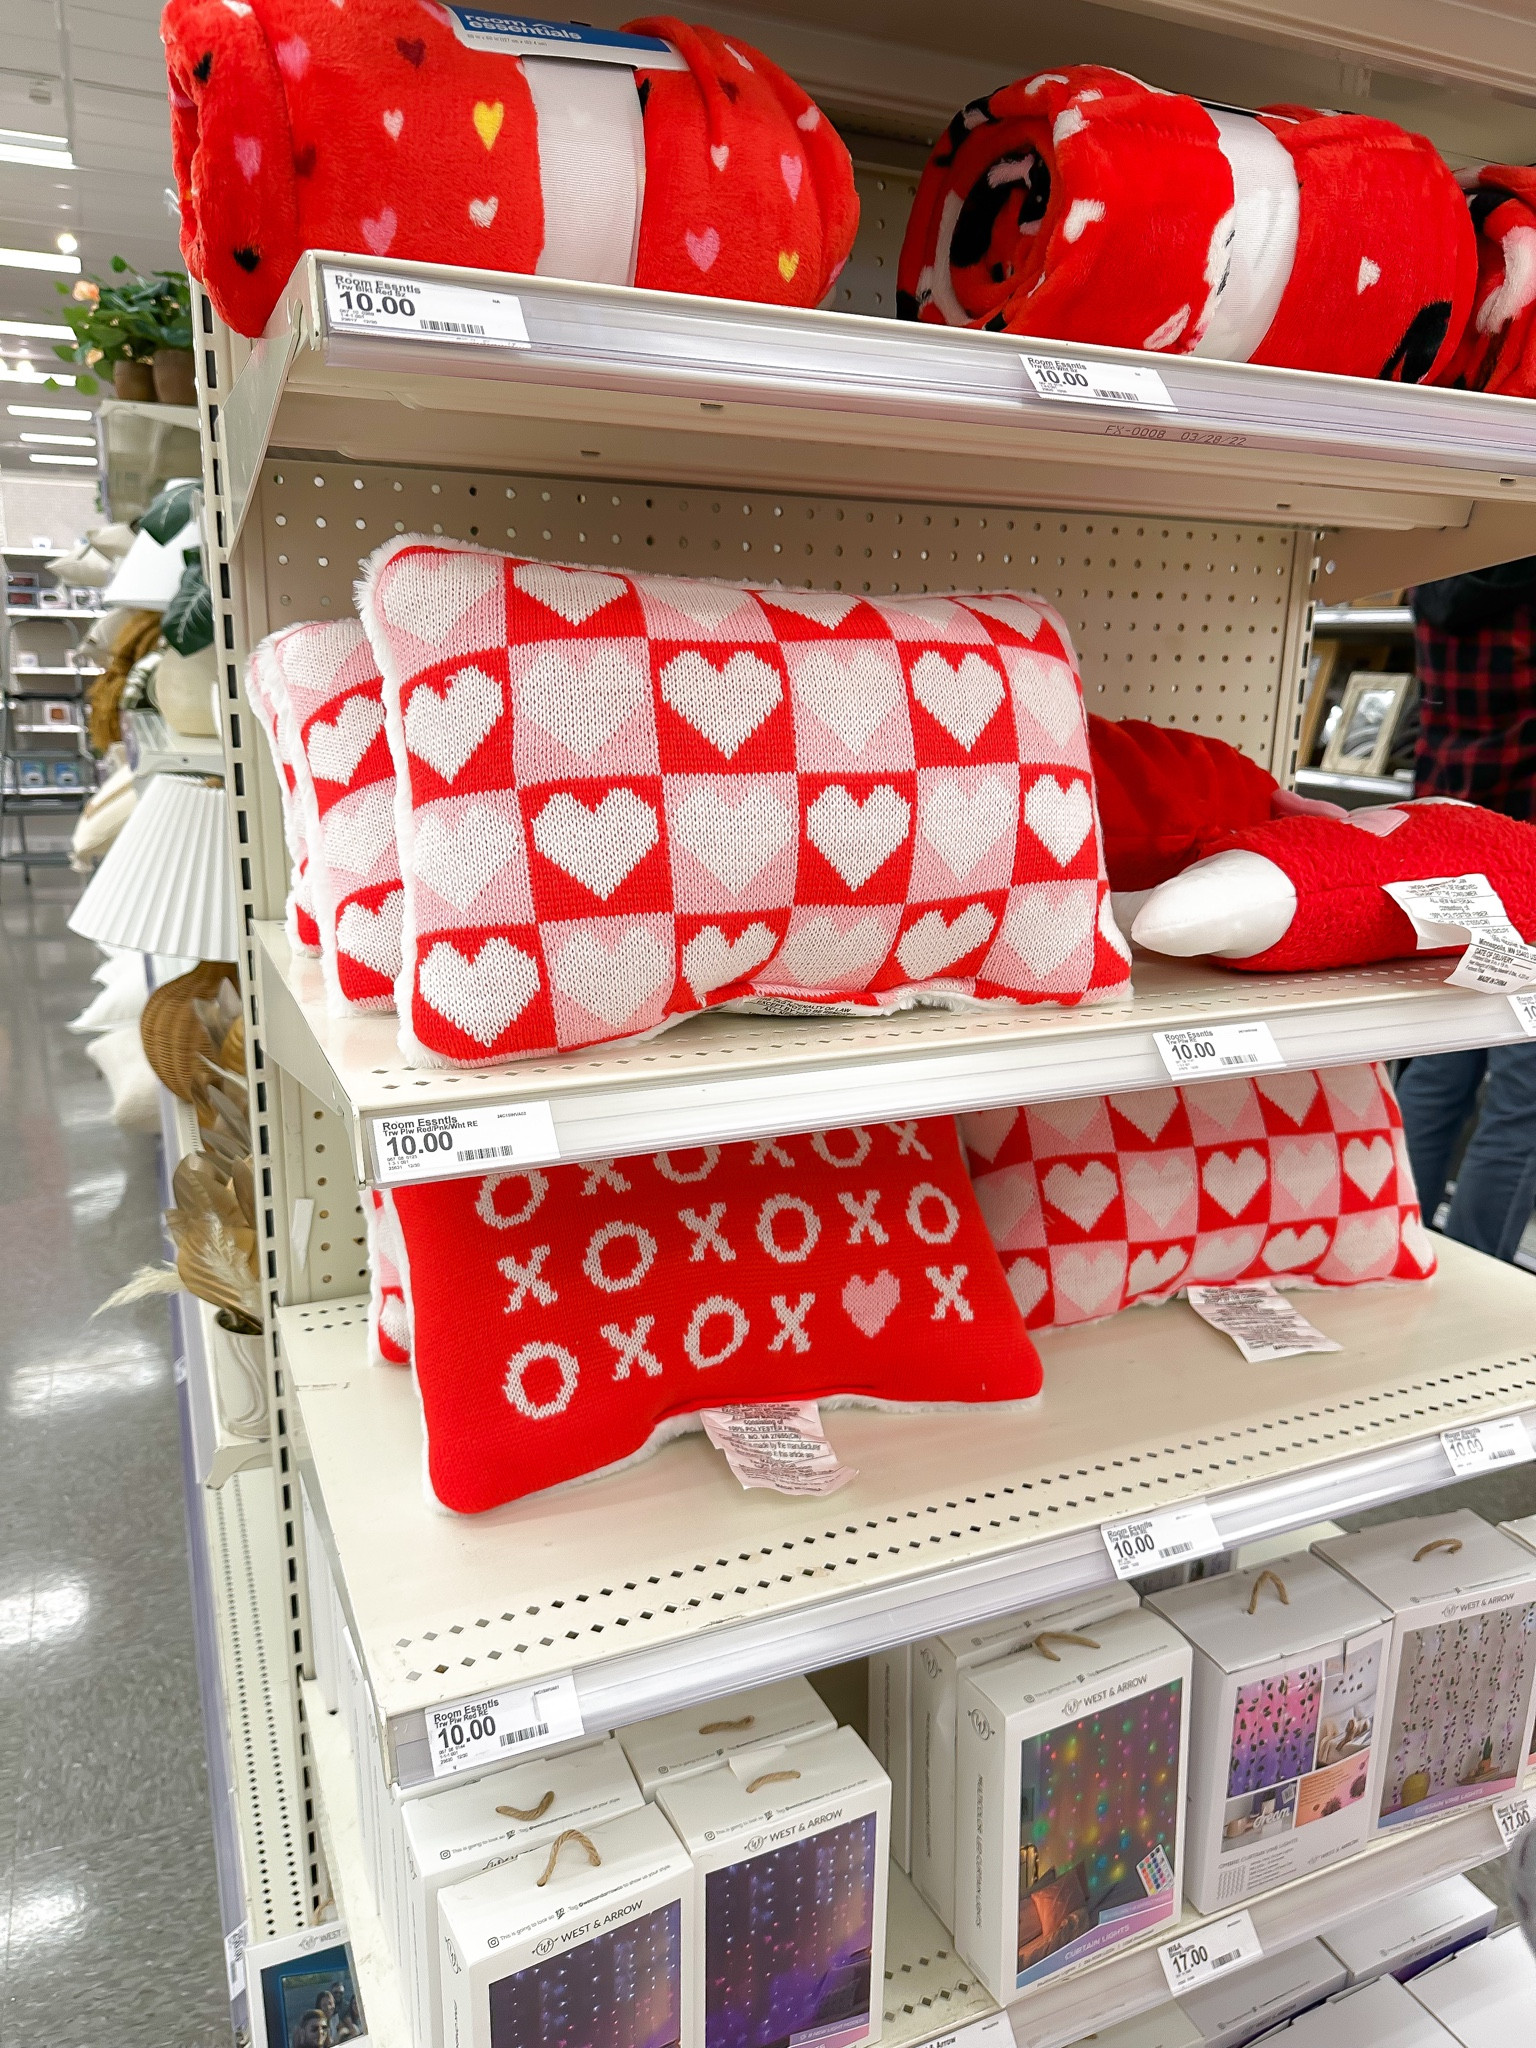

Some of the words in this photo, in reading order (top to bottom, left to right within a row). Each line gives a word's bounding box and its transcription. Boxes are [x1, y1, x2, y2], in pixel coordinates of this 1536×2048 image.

[464, 14, 526, 27] room
[468, 21, 581, 40] essentials
[335, 274, 372, 288] Room
[376, 280, 421, 294] Essntls
[340, 291, 416, 317] 10.00
[1027, 357, 1054, 367] Room
[1054, 360, 1087, 370] Essntls
[1035, 369, 1089, 387] 10.00
[1104, 424, 1167, 439] FX-0008
[1180, 432, 1247, 446] 03/28/22
[1187, 1030, 1214, 1038] Essntls
[1172, 1042, 1216, 1060] 10.00
[382, 1121, 415, 1131] Room
[418, 1116, 458, 1127] Essntls
[417, 1122, 466, 1134] Red/Pnk/Wht
[467, 1120, 479, 1128] RE
[386, 1131, 453, 1157] 10.00
[497, 1244, 559, 1314] X
[582, 1219, 658, 1293] O
[678, 1202, 737, 1263] X
[756, 1193, 822, 1264] O
[837, 1189, 890, 1245] X
[906, 1182, 960, 1245] O
[503, 1340, 580, 1420] O
[600, 1314, 663, 1382] X
[684, 1294, 750, 1371] O
[768, 1292, 816, 1354] X
[926, 1264, 974, 1322] X
[1450, 1438, 1484, 1458] 10.00
[1114, 1534, 1155, 1558] 10.00
[1460, 1601, 1480, 1612] WEST
[1488, 1592, 1515, 1605] ARROW
[1084, 1690, 1107, 1706] WEST
[1109, 1687, 1115, 1697] &
[1117, 1674, 1148, 1694] ARROW
[434, 1709, 462, 1723] Room
[464, 1699, 500, 1715] Essntls
[438, 1716, 496, 1749] 10.00
[770, 1825, 797, 1842] WEST
[799, 1822, 806, 1831] &
[808, 1808, 844, 1829] ARROW
[1252, 1804, 1291, 1829] dream
[1502, 1809, 1530, 1832] 17.00
[499, 1932, 511, 1941] This
[516, 1924, 532, 1935] going
[561, 1923, 592, 1943] WEST
[593, 1920, 602, 1930] &
[603, 1900, 643, 1926] ARROW
[1102, 1924, 1130, 1943] LIGHTS
[1173, 1946, 1208, 1974] 17.00
